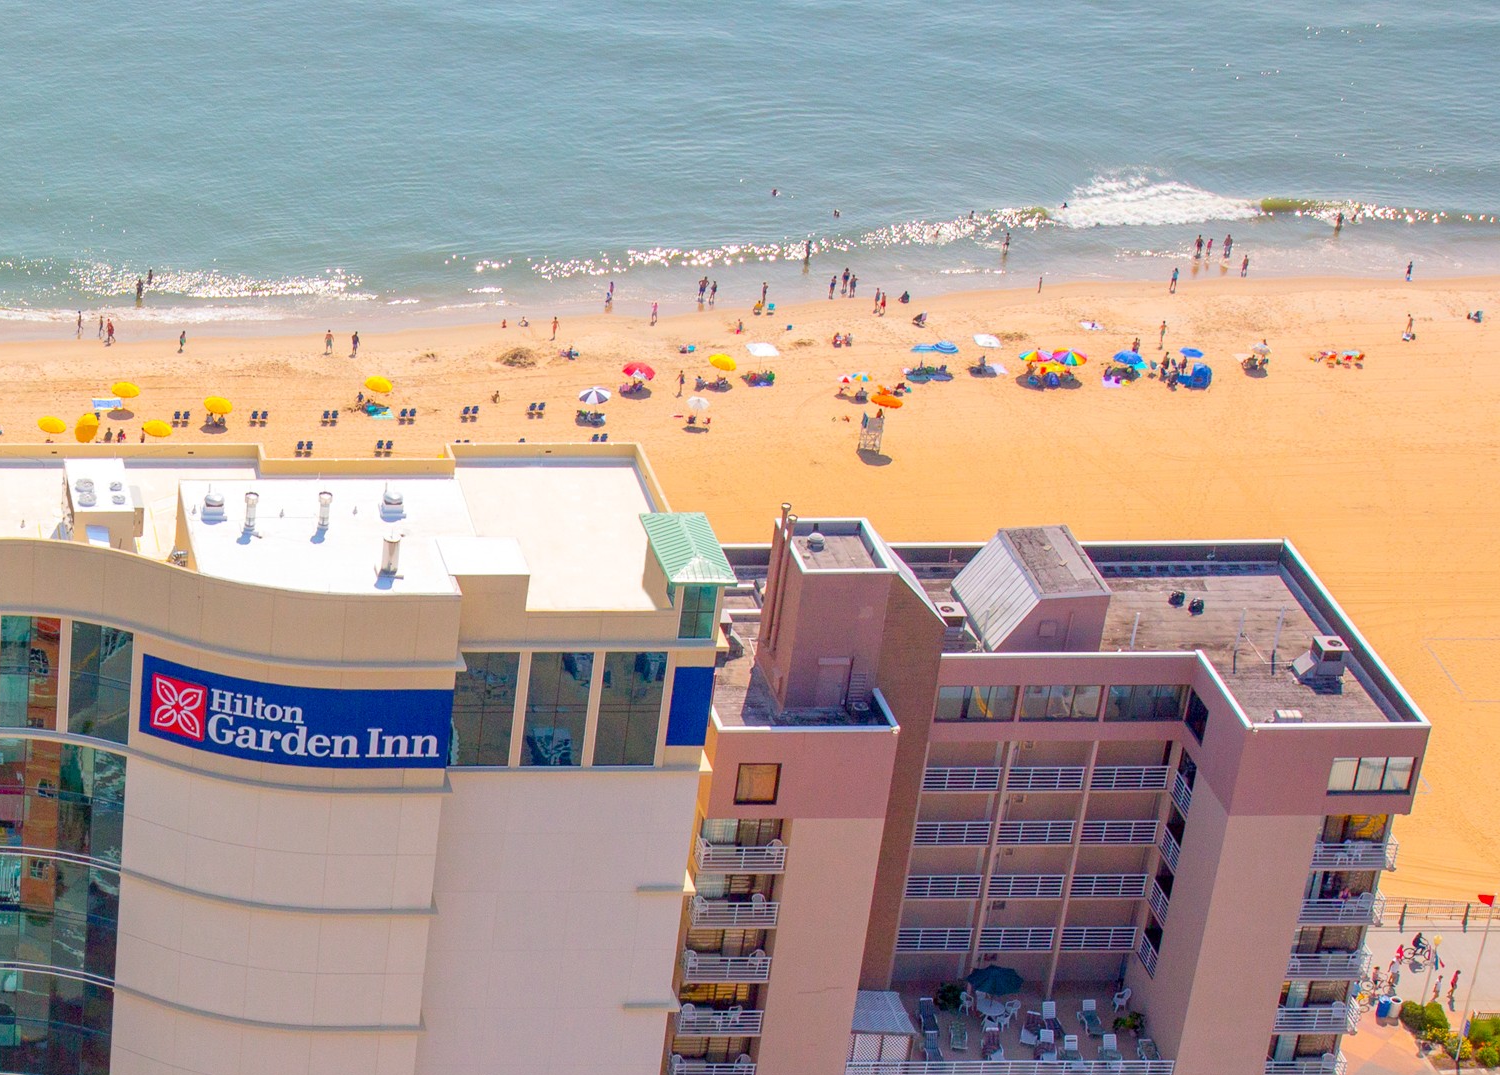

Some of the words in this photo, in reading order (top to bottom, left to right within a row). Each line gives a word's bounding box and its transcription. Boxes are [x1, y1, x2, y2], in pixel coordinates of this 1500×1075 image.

[209, 688, 304, 724] Hilton
[207, 714, 359, 758] Garden
[365, 728, 440, 758] Inn
